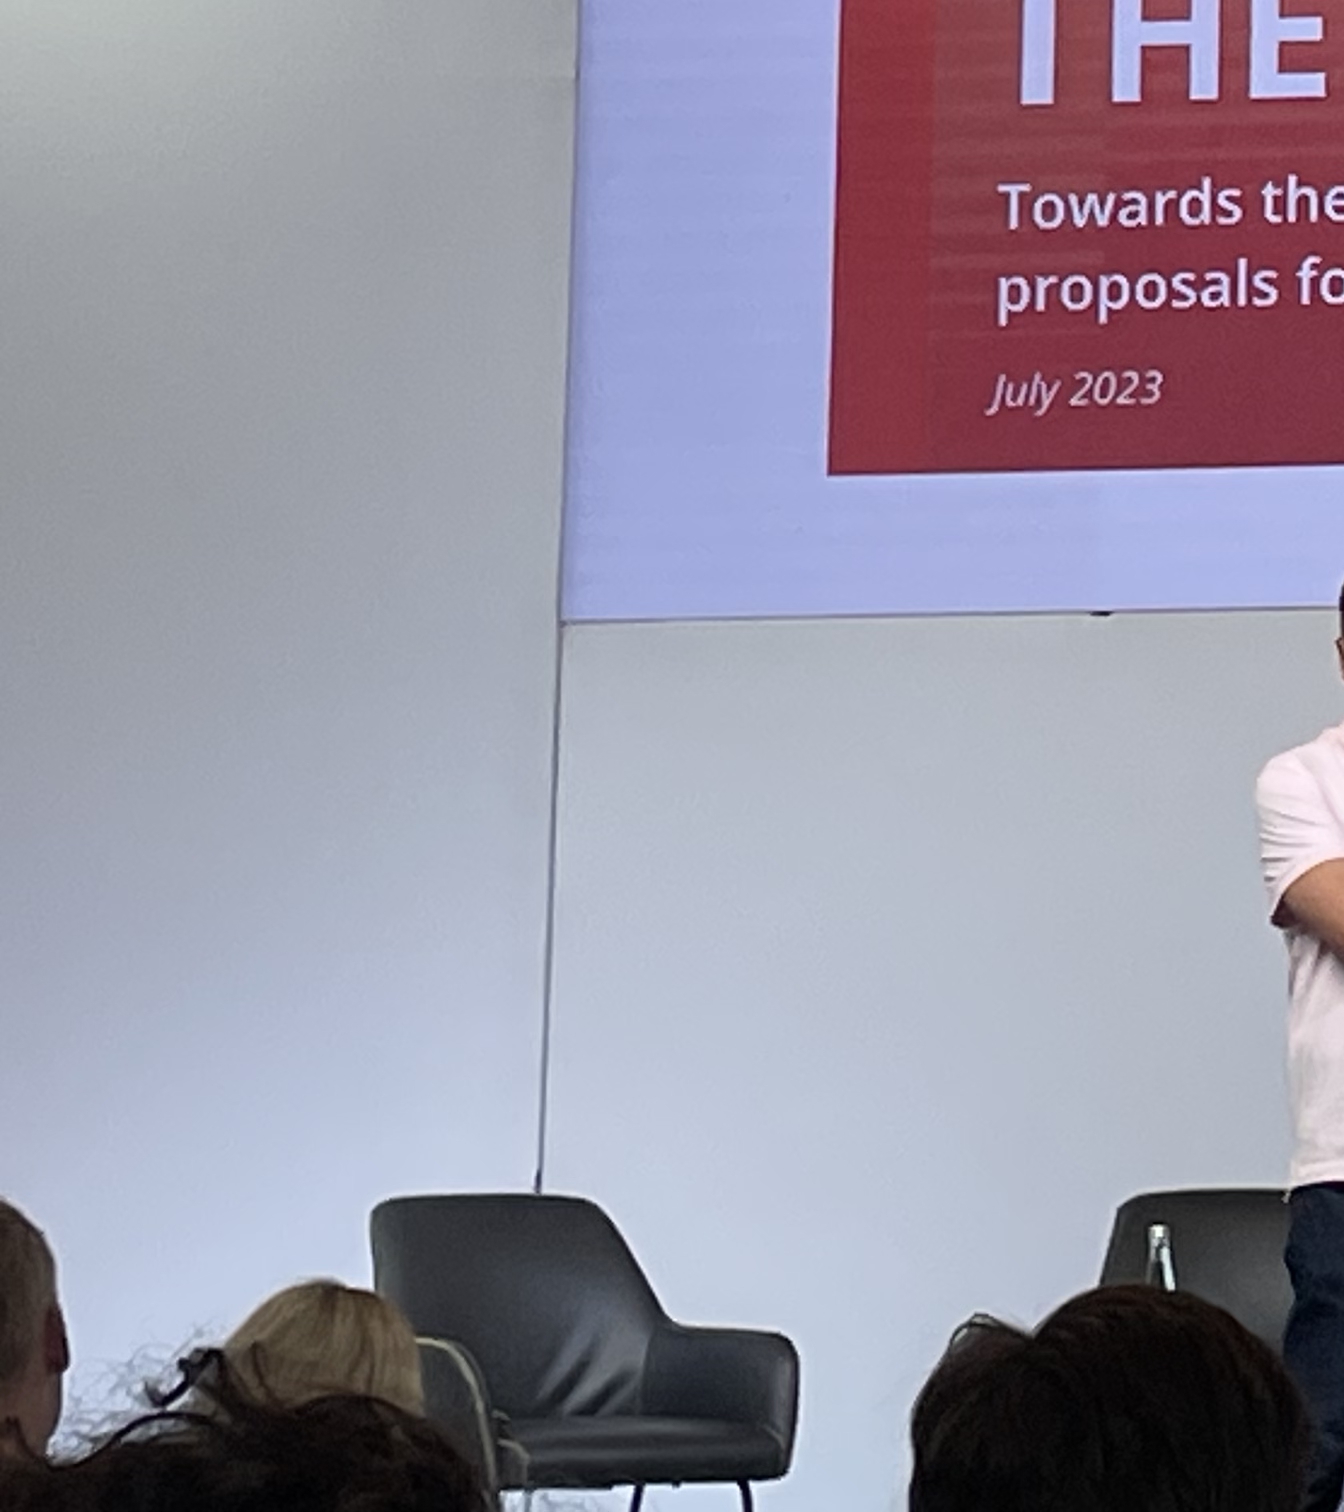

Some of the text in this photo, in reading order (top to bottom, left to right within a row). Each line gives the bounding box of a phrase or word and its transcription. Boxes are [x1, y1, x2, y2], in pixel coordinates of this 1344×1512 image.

[996, 176, 1243, 231] Towards
[998, 257, 1279, 327] proposals
[985, 369, 1164, 417] July 2023
